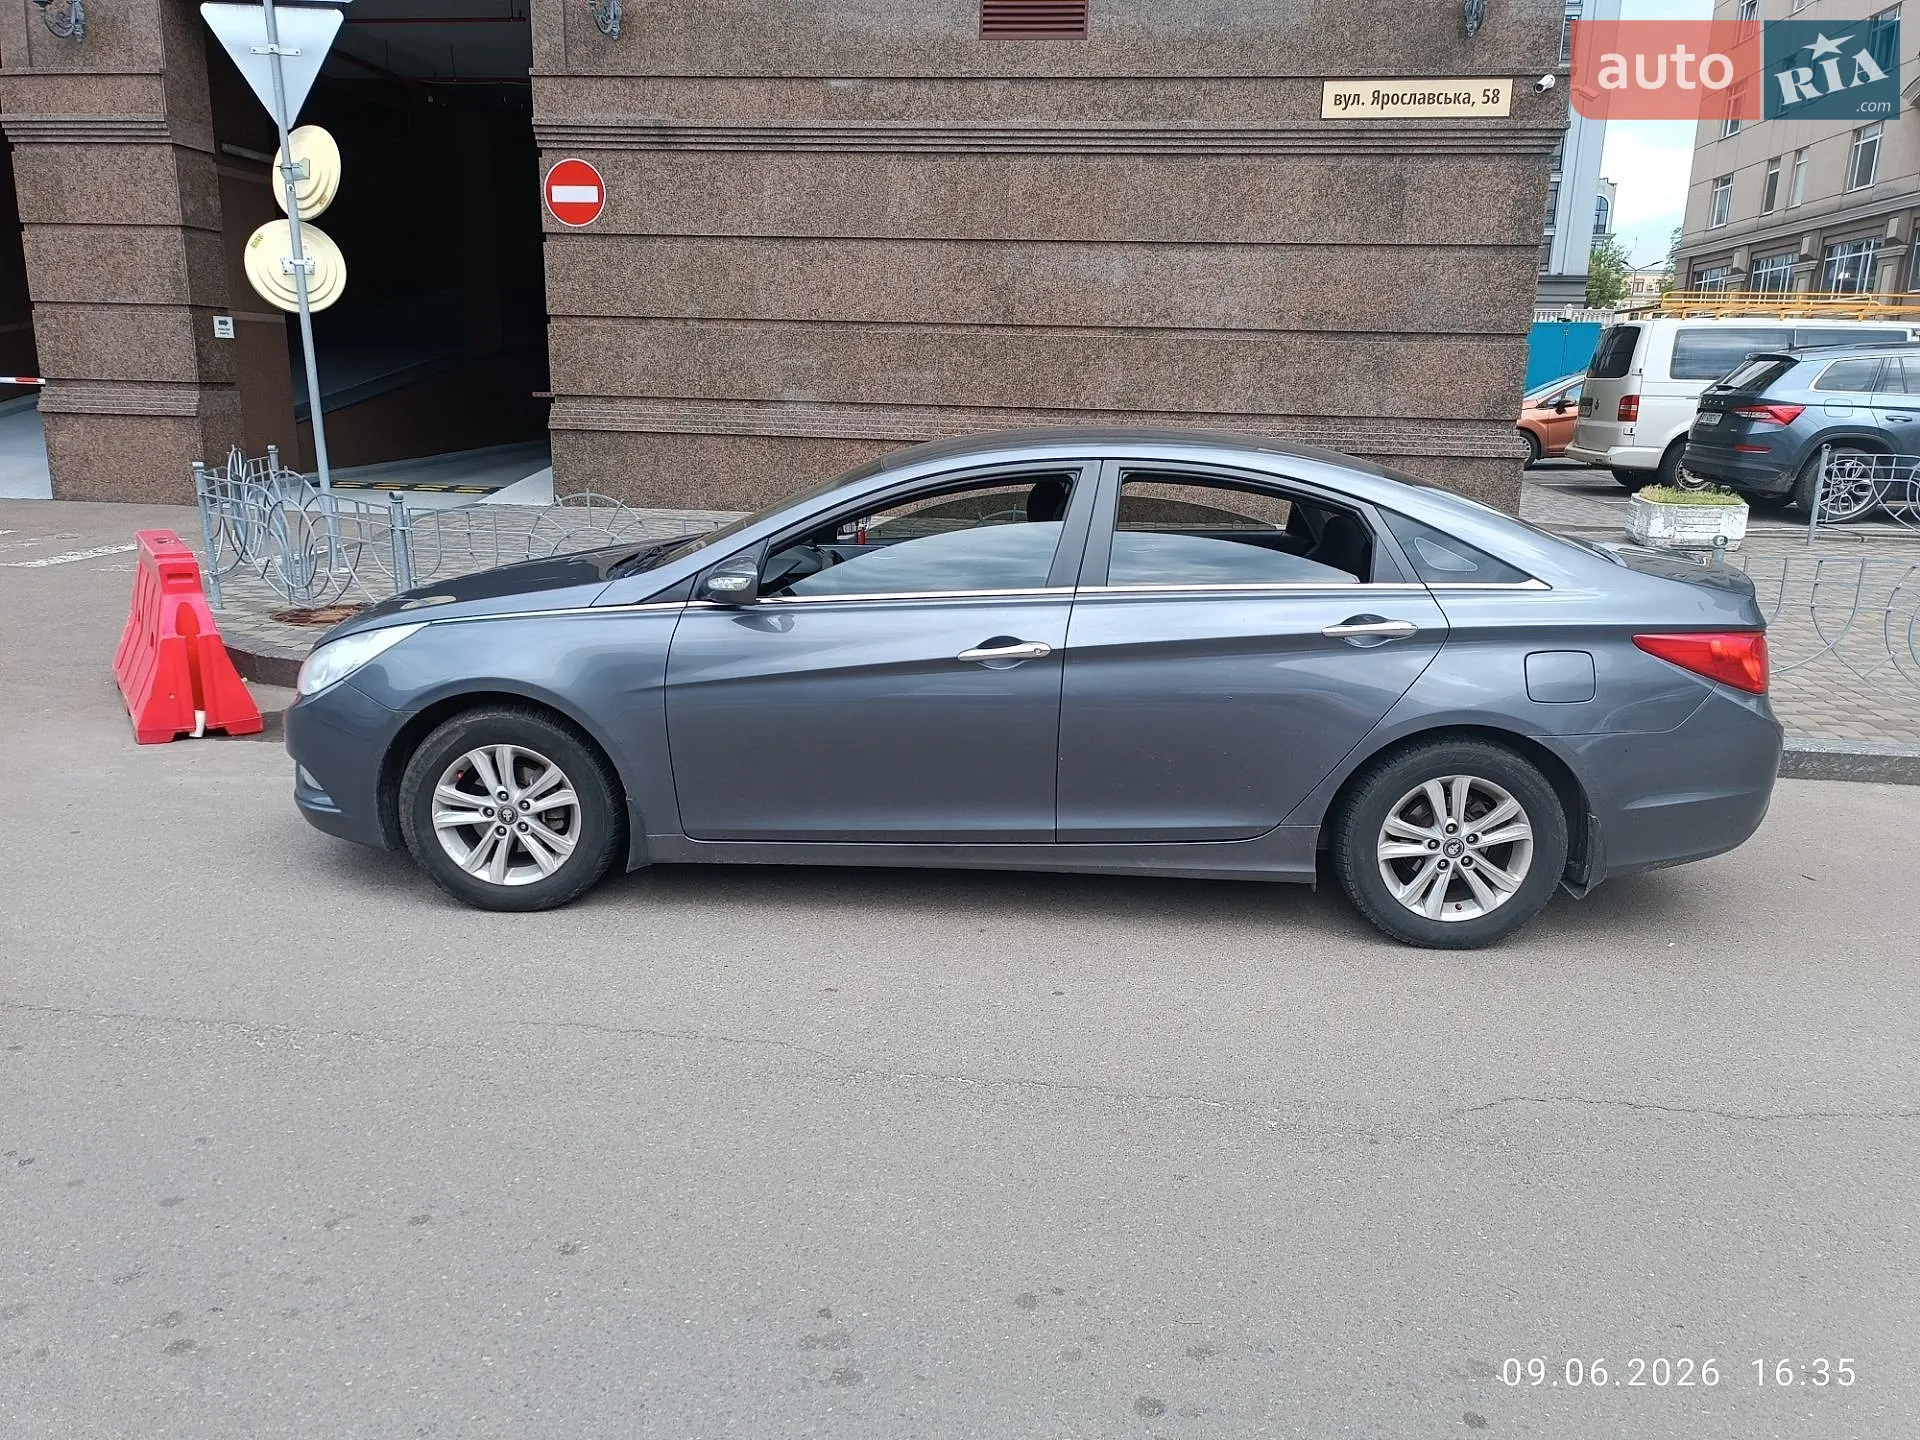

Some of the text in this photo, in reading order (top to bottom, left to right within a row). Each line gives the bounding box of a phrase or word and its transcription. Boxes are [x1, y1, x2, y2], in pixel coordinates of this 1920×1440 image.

[1333, 88, 1501, 111] вул. Ярославська, 58
